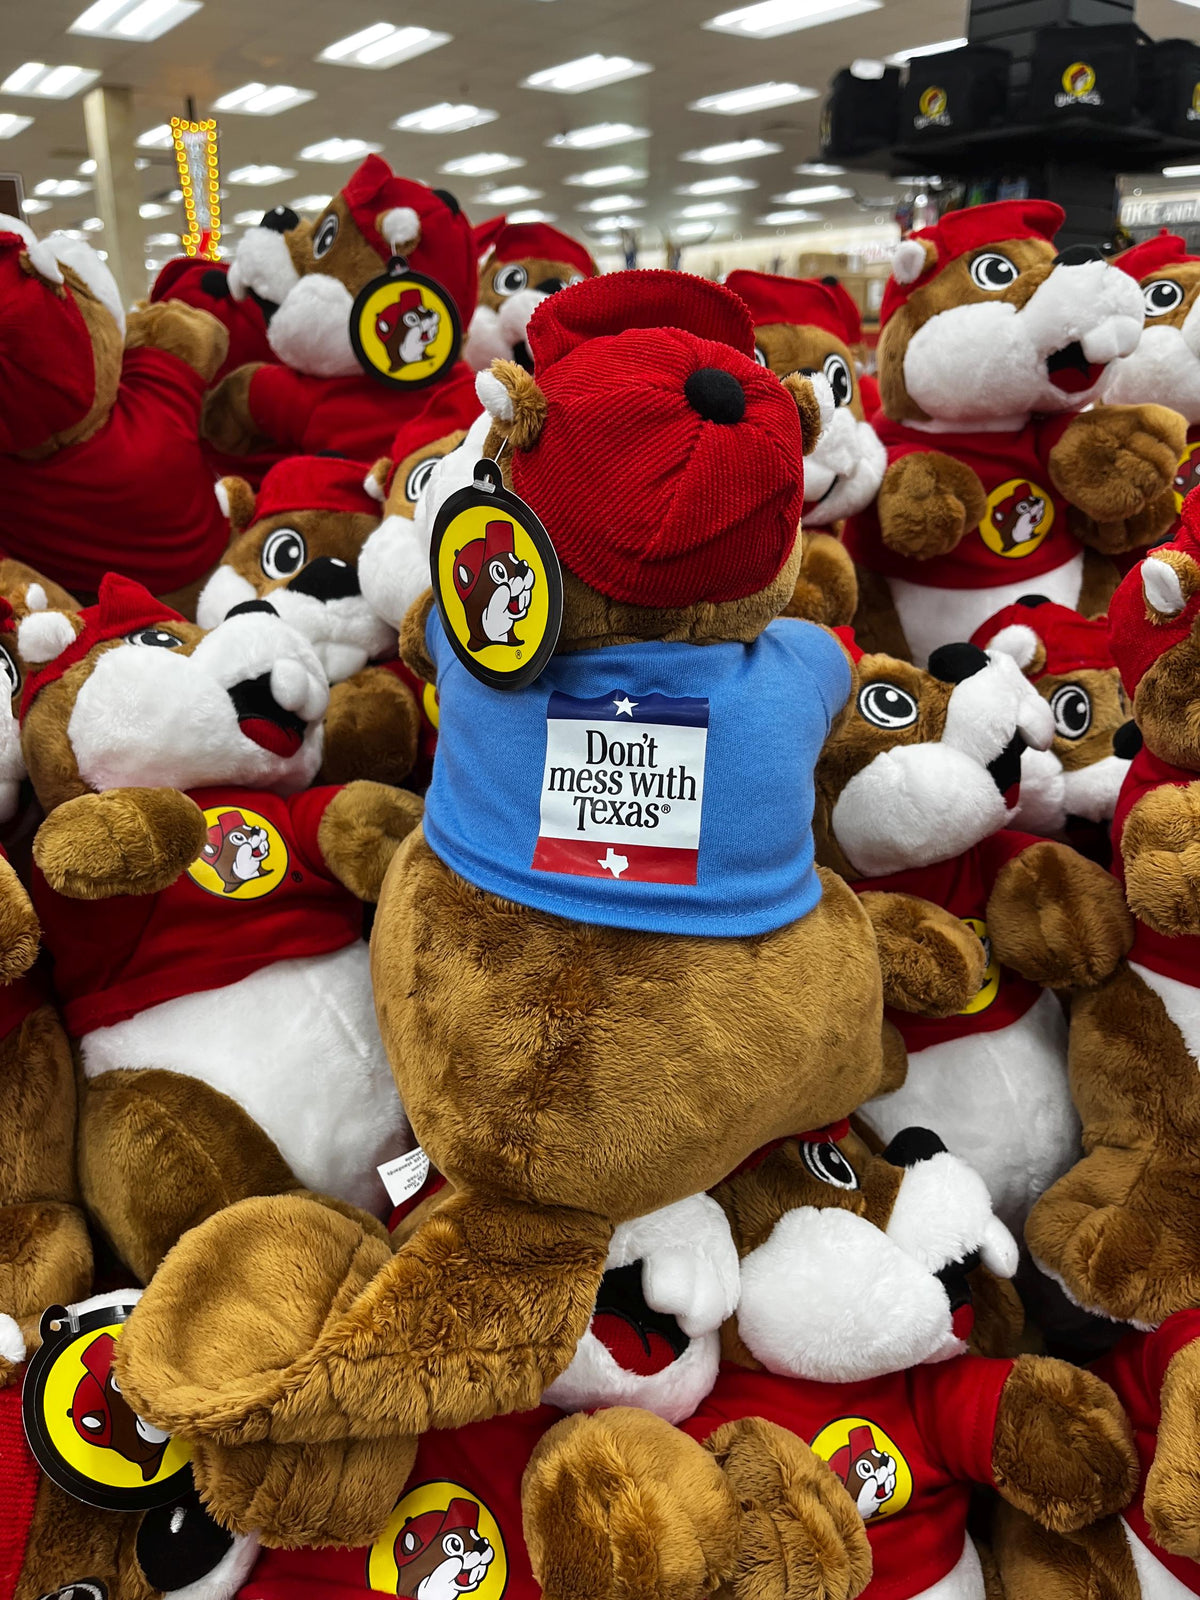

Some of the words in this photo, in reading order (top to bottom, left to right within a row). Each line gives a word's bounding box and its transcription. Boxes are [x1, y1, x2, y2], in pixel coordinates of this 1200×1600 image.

[585, 729, 659, 769] Don't
[547, 766, 624, 796] mess
[629, 765, 697, 801] with
